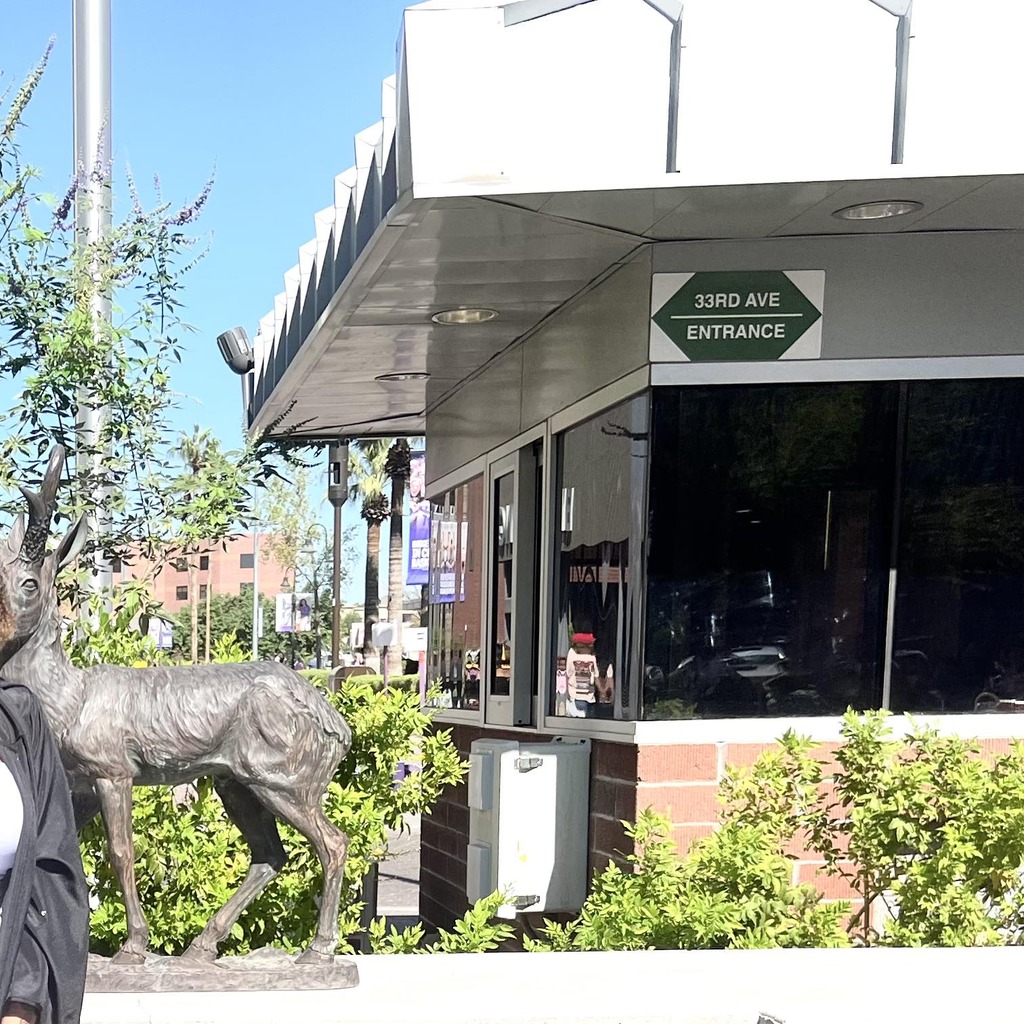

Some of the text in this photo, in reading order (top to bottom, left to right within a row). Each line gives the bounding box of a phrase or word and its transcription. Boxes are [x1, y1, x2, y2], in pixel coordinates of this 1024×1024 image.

[694, 292, 780, 309] 33RD AVE
[686, 323, 785, 340] ENTRANCE
